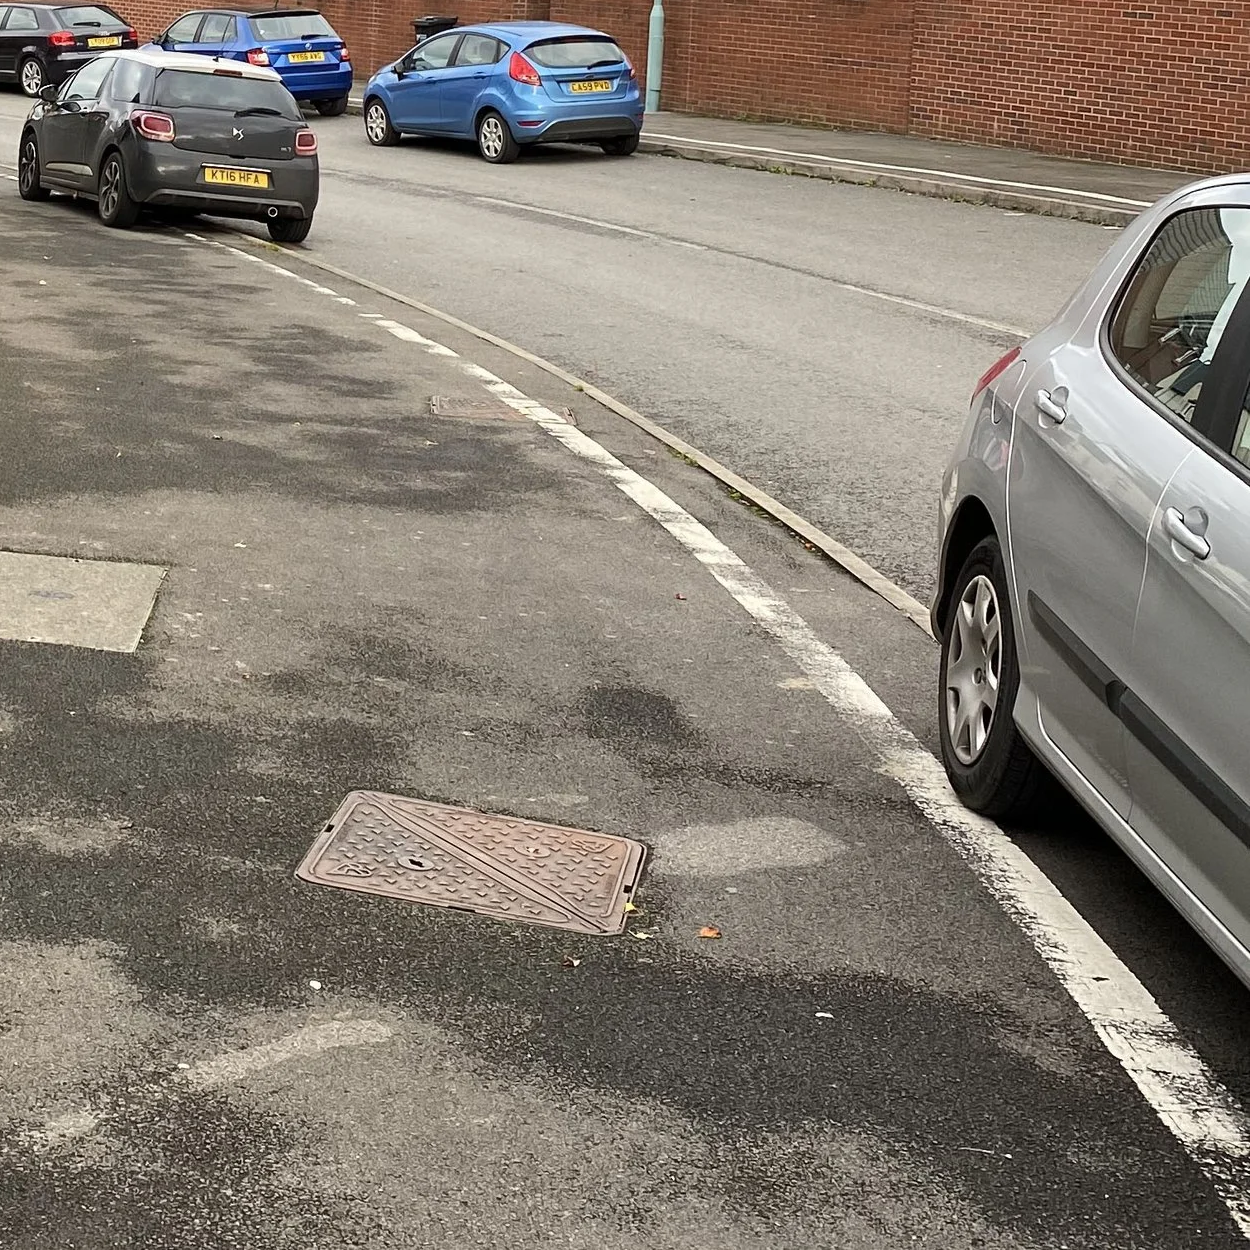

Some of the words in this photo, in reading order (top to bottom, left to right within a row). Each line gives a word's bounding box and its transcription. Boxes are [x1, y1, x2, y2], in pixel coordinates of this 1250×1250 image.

[572, 83, 593, 91] CA59
[594, 81, 610, 90] PVD
[211, 170, 236, 182] KT16
[239, 172, 259, 184] HFA
